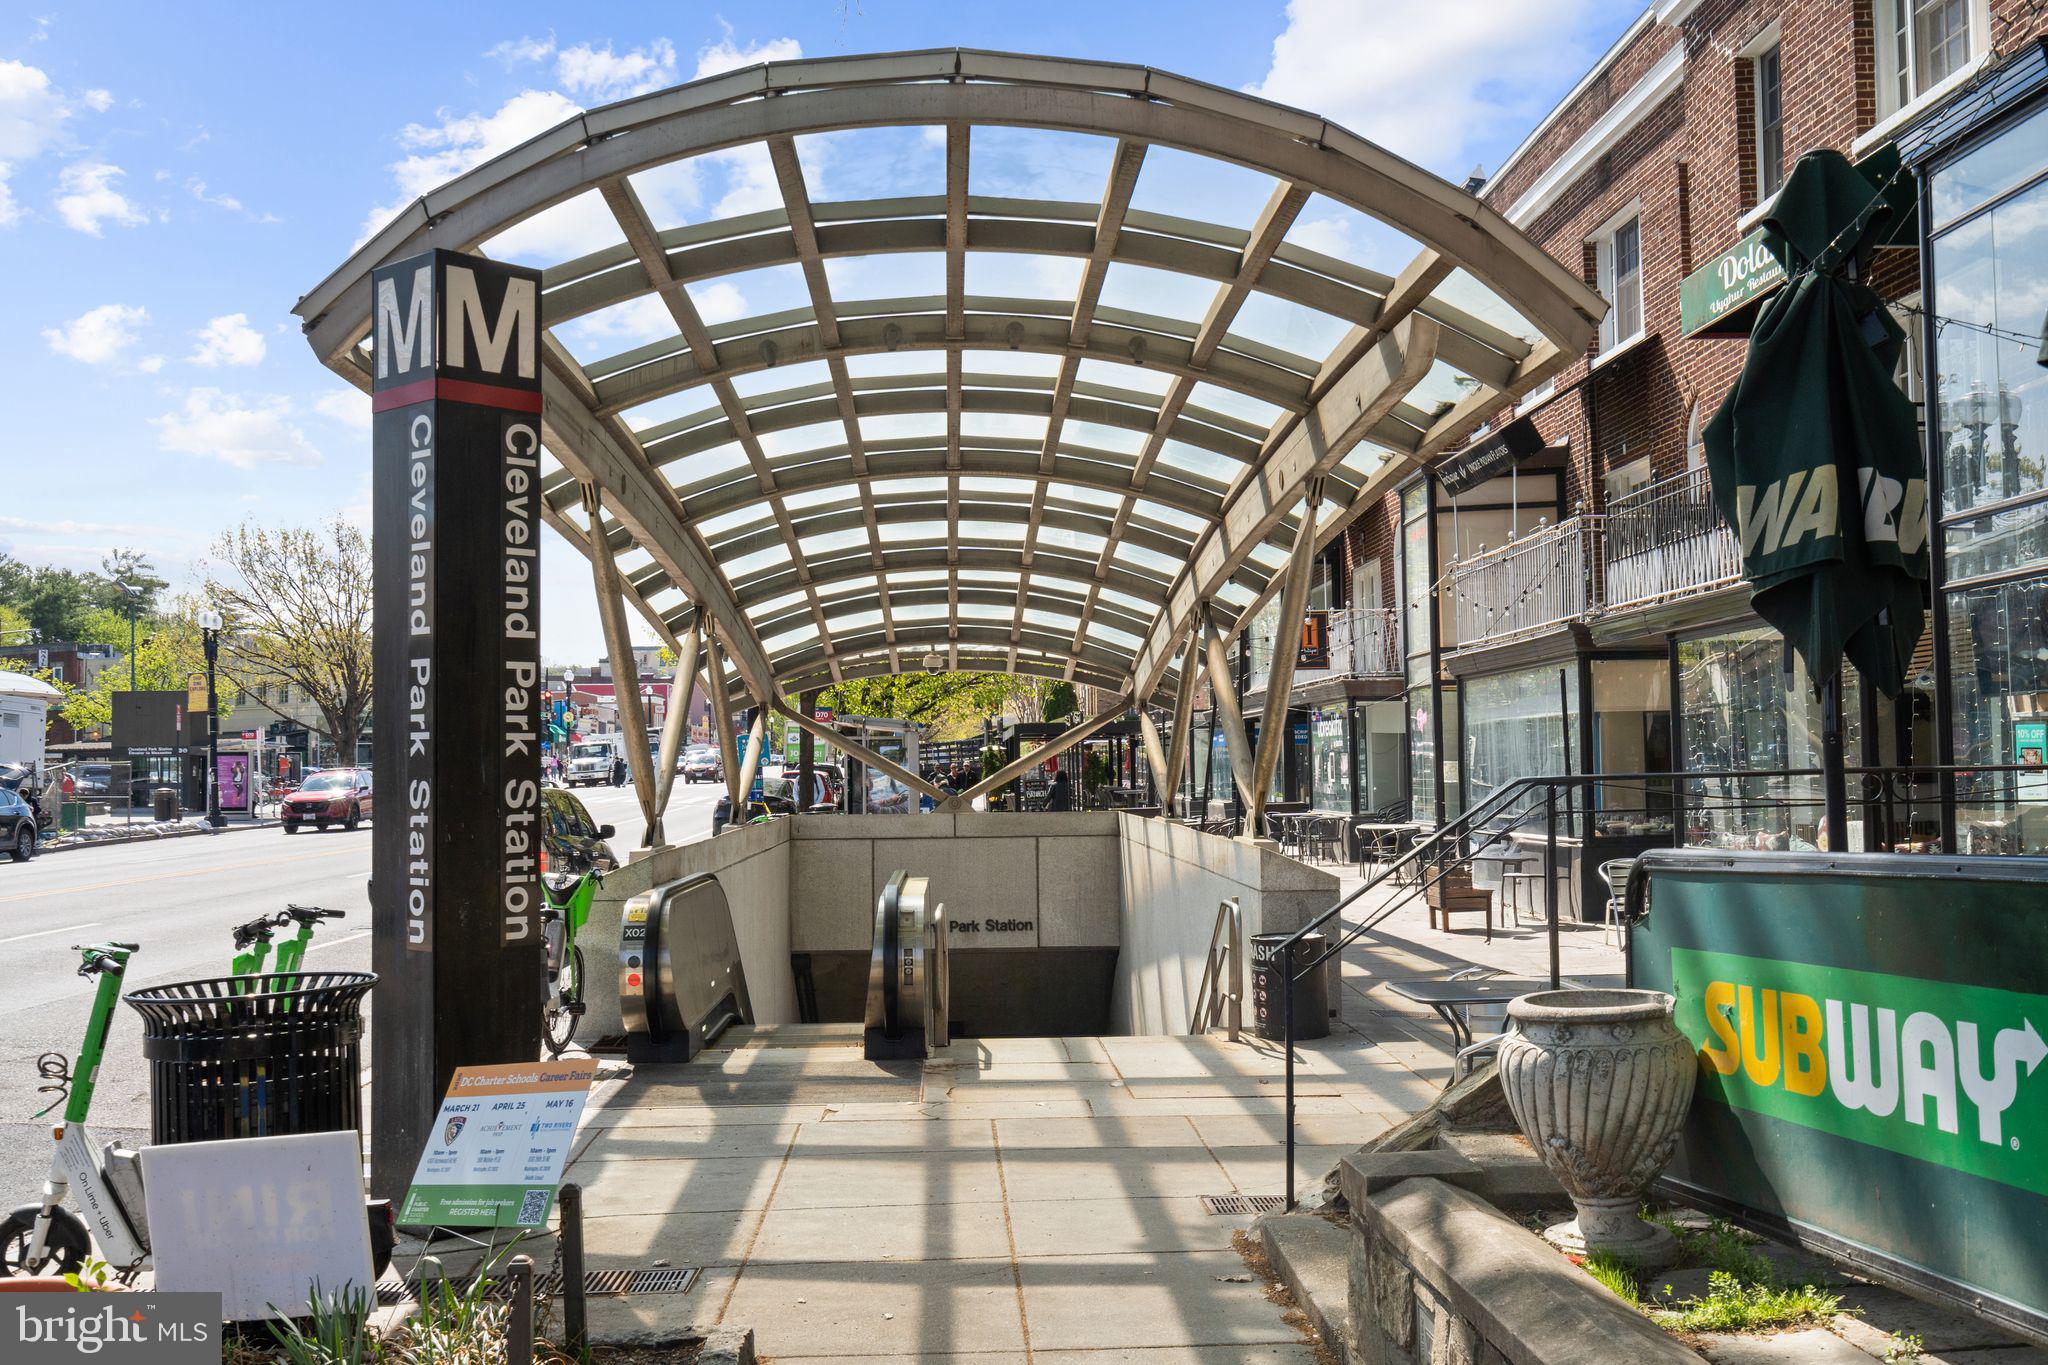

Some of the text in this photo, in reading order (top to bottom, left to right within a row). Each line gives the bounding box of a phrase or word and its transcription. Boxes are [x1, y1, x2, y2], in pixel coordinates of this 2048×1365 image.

[1718, 243, 1776, 290] Dola
[1747, 264, 1784, 291] Restau
[378, 265, 431, 379] M
[446, 264, 535, 379] M
[1737, 464, 1839, 559] WA
[409, 414, 432, 944] Cleveland Park Station
[505, 423, 538, 940] Cleveland Park Station
[2031, 729, 2044, 739] OFF
[949, 921, 980, 933] Park
[985, 919, 1033, 932] Station
[460, 1077, 474, 1087] DC
[474, 1075, 505, 1086] Charter
[506, 1073, 539, 1084] Schools
[540, 1072, 569, 1082] Career
[570, 1070, 592, 1080] Fairs
[1701, 980, 2048, 1146] SUBWAY
[492, 1102, 525, 1111] APRIL 25
[545, 1099, 574, 1108] MAY 16
[79, 1172, 89, 1188] On
[85, 1186, 99, 1210] Lime
[99, 1216, 114, 1240] Uber
[449, 1208, 479, 1216] REGISTER
